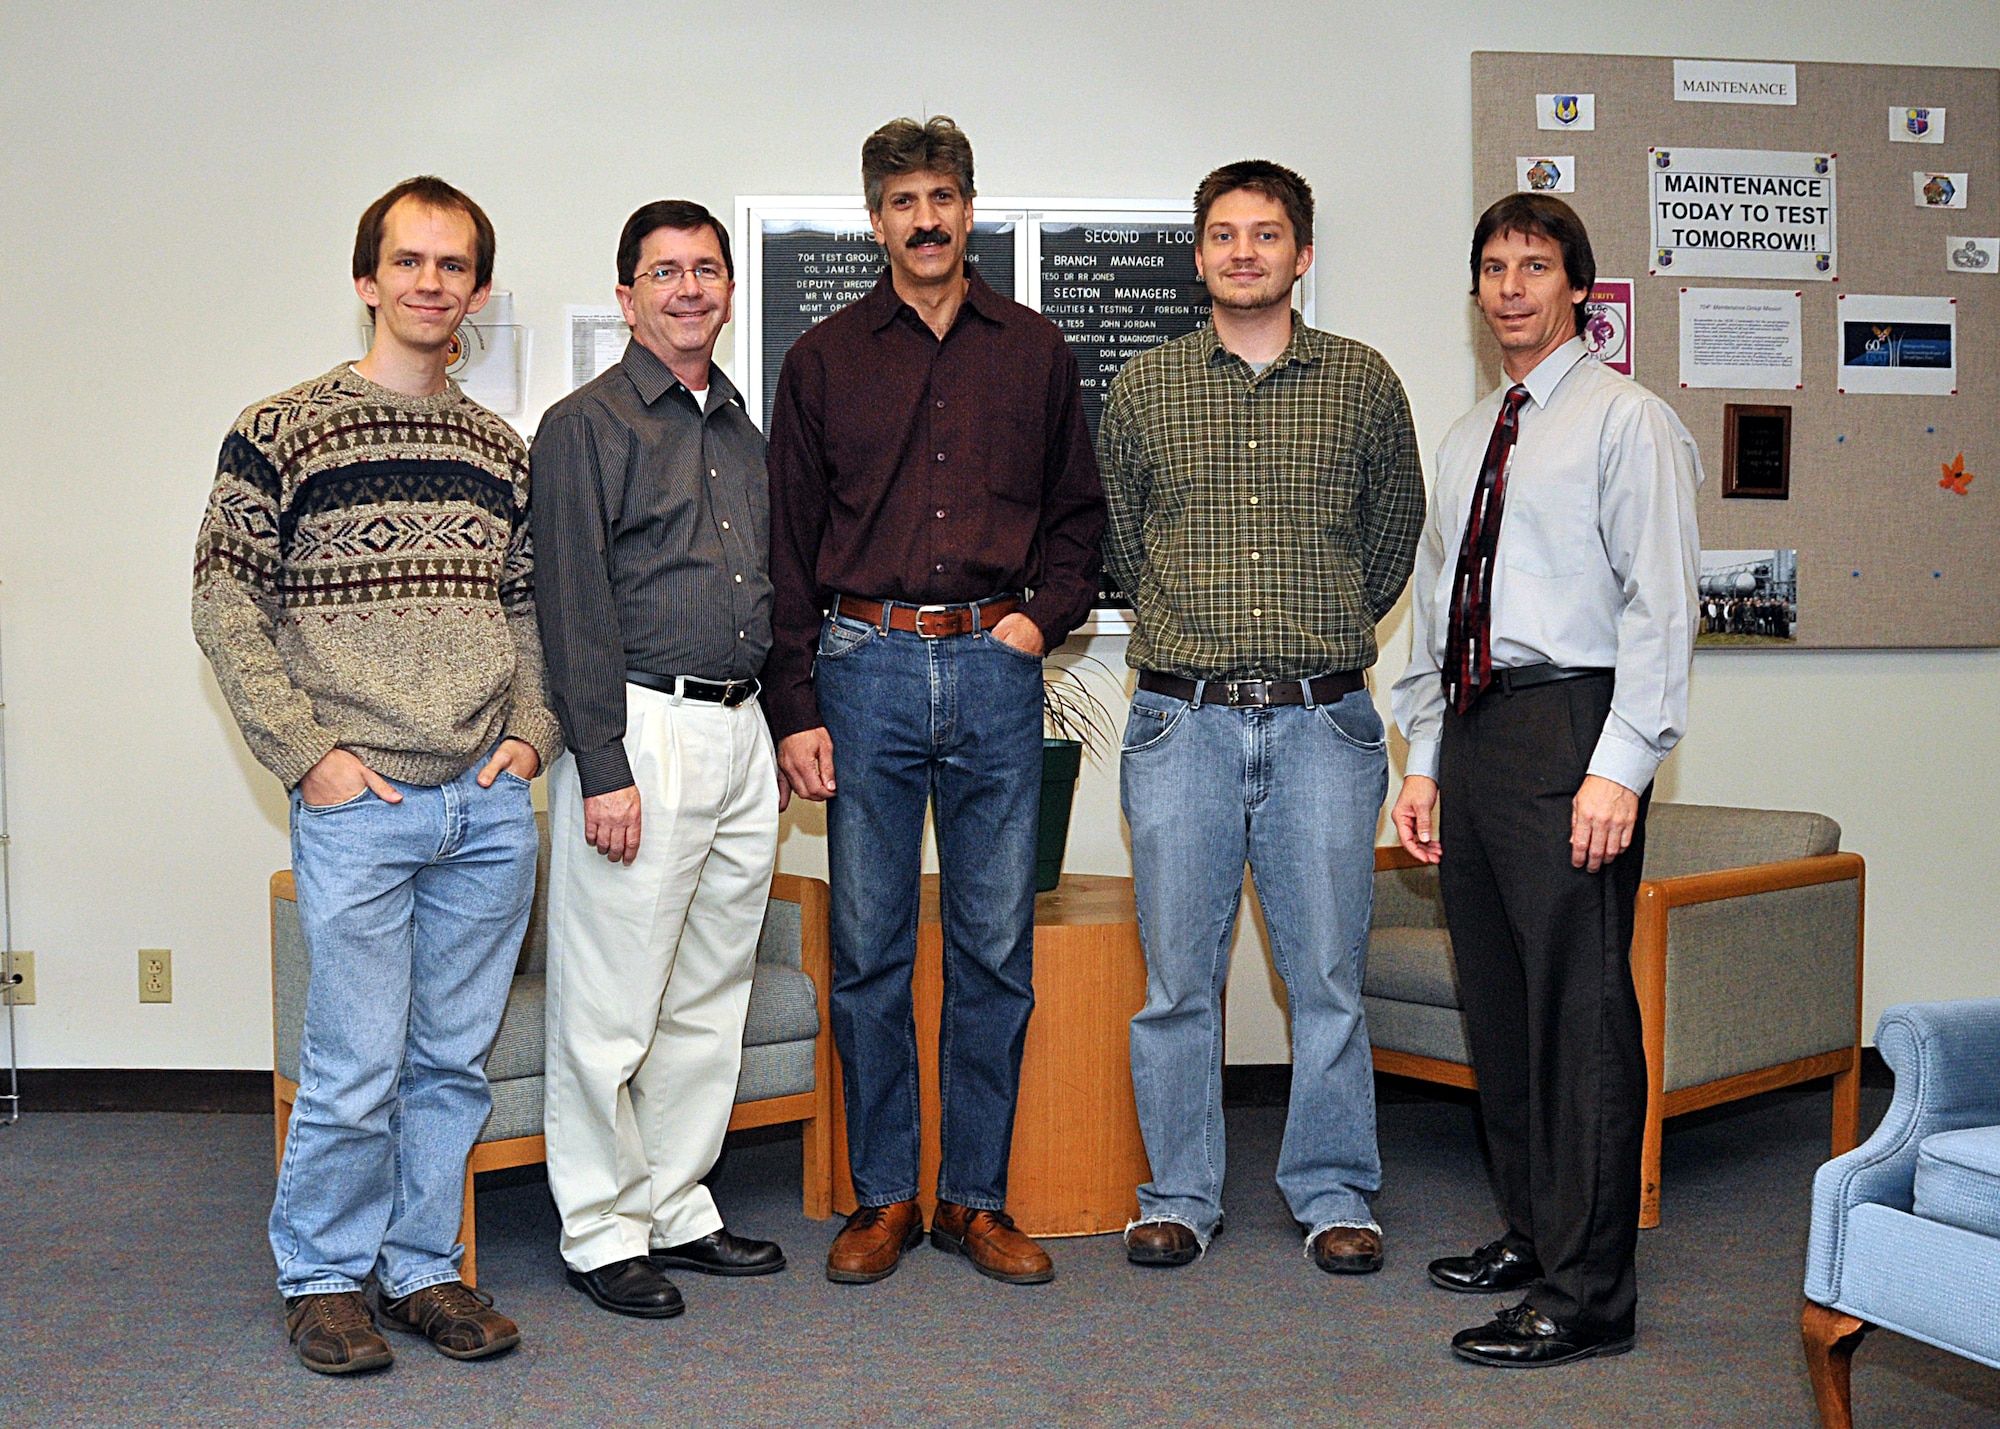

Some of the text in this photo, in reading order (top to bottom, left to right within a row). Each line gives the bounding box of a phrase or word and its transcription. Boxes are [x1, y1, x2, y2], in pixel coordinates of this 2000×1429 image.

[1683, 80, 1787, 96] MAINTENANCE
[1665, 175, 1822, 197] MAINTENANCE
[1658, 202, 1829, 225] TODAY TO TEST
[1085, 230, 1140, 244] SECOND
[1672, 229, 1816, 251] TOMORROW!!
[797, 253, 815, 262] 704
[821, 253, 842, 262] TEST
[845, 253, 879, 262] GROUP
[1054, 255, 1165, 267] BRANCH MANAGER
[804, 265, 820, 274] COL
[825, 265, 856, 274] JAMES
[861, 266, 868, 274] A
[1064, 273, 1074, 281] DR
[1078, 273, 1089, 281] RR
[1091, 273, 1116, 282] JONES
[805, 292, 817, 300] MR
[822, 292, 833, 301] W
[1053, 287, 1177, 299] SECTION MANAGERS
[1590, 292, 1616, 300] URITY
[799, 304, 822, 312] MGMT
[1041, 305, 1086, 313] FACILITIES
[1088, 305, 1094, 313] &
[1099, 305, 1134, 314] TESTING
[1154, 306, 1190, 314] FOREIGN
[1067, 320, 1085, 328] TE55
[1099, 320, 1121, 328] JOHN
[1123, 320, 1157, 328] JORDAN
[1109, 335, 1115, 343] &
[1119, 335, 1169, 343] DIAGNOSTICS
[1100, 350, 1117, 358] DON
[1099, 364, 1119, 372] CARL
[1101, 379, 1107, 387] &
